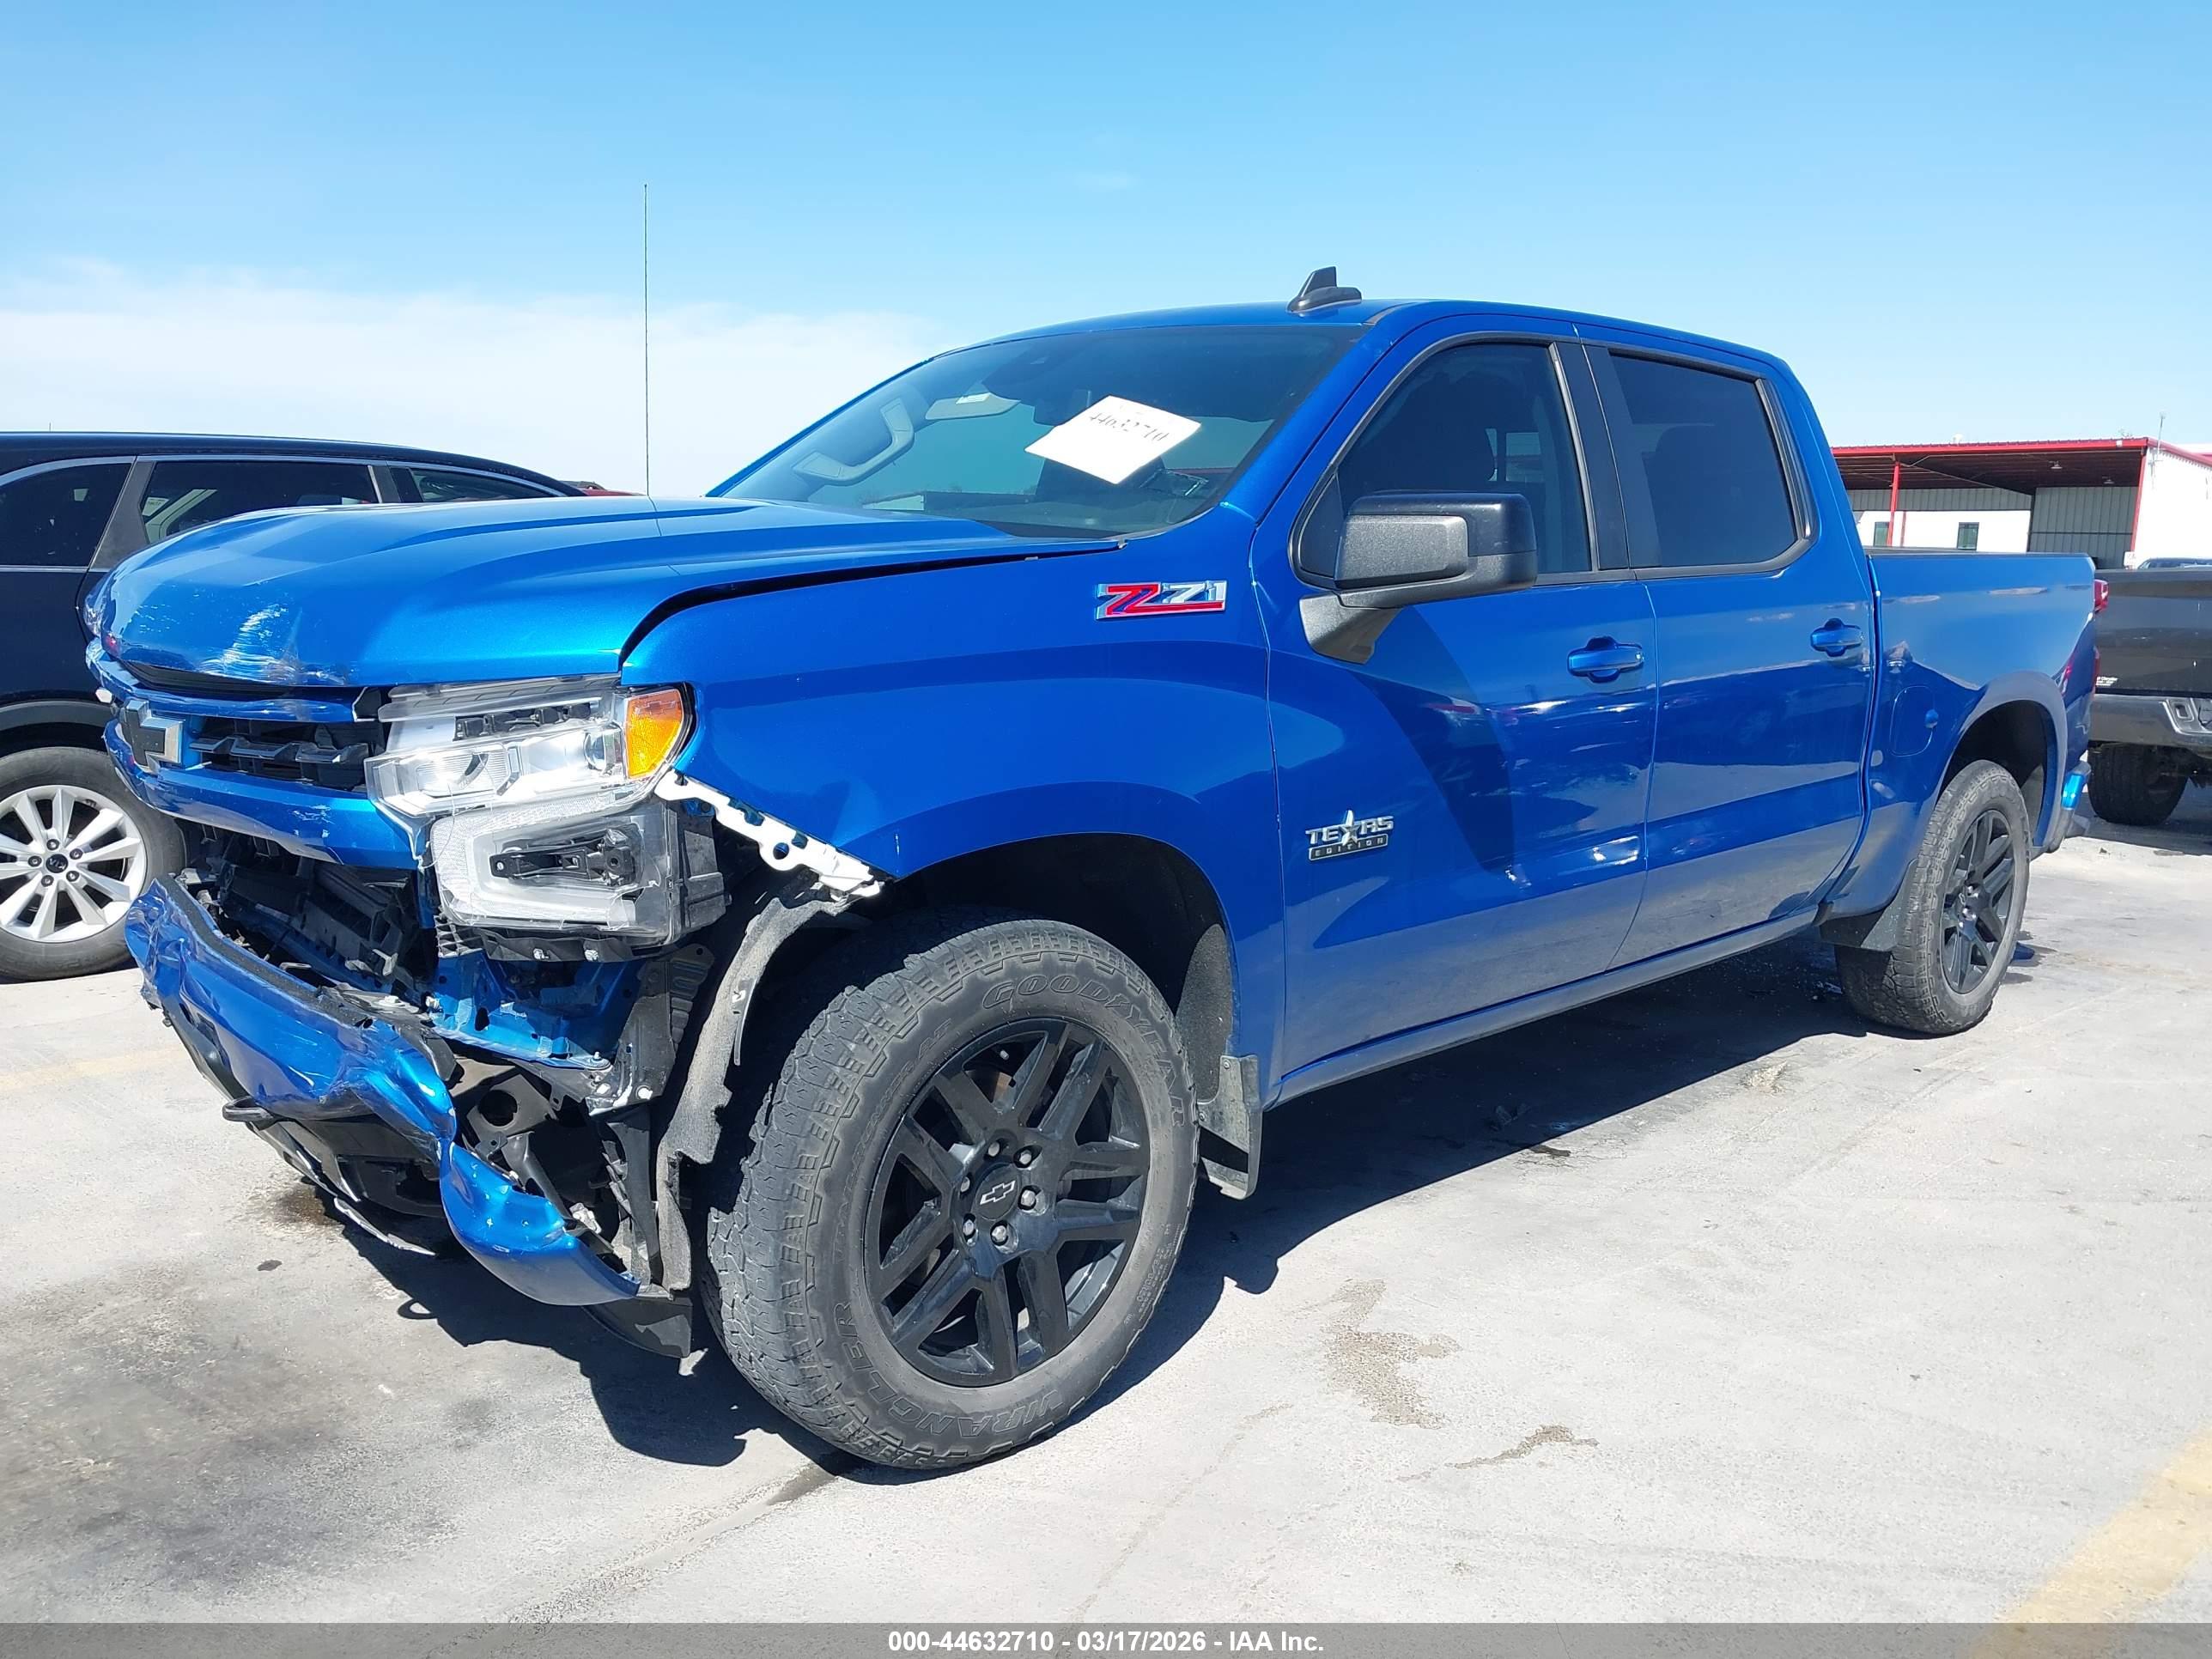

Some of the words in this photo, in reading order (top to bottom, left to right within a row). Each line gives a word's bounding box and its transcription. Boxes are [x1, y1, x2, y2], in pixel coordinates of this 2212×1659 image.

[1095, 580, 1228, 620] Z71
[1314, 837, 1384, 857] EDITION
[981, 974, 1186, 1127] GOODYEAR
[832, 1300, 1066, 1438] WRANGLER
